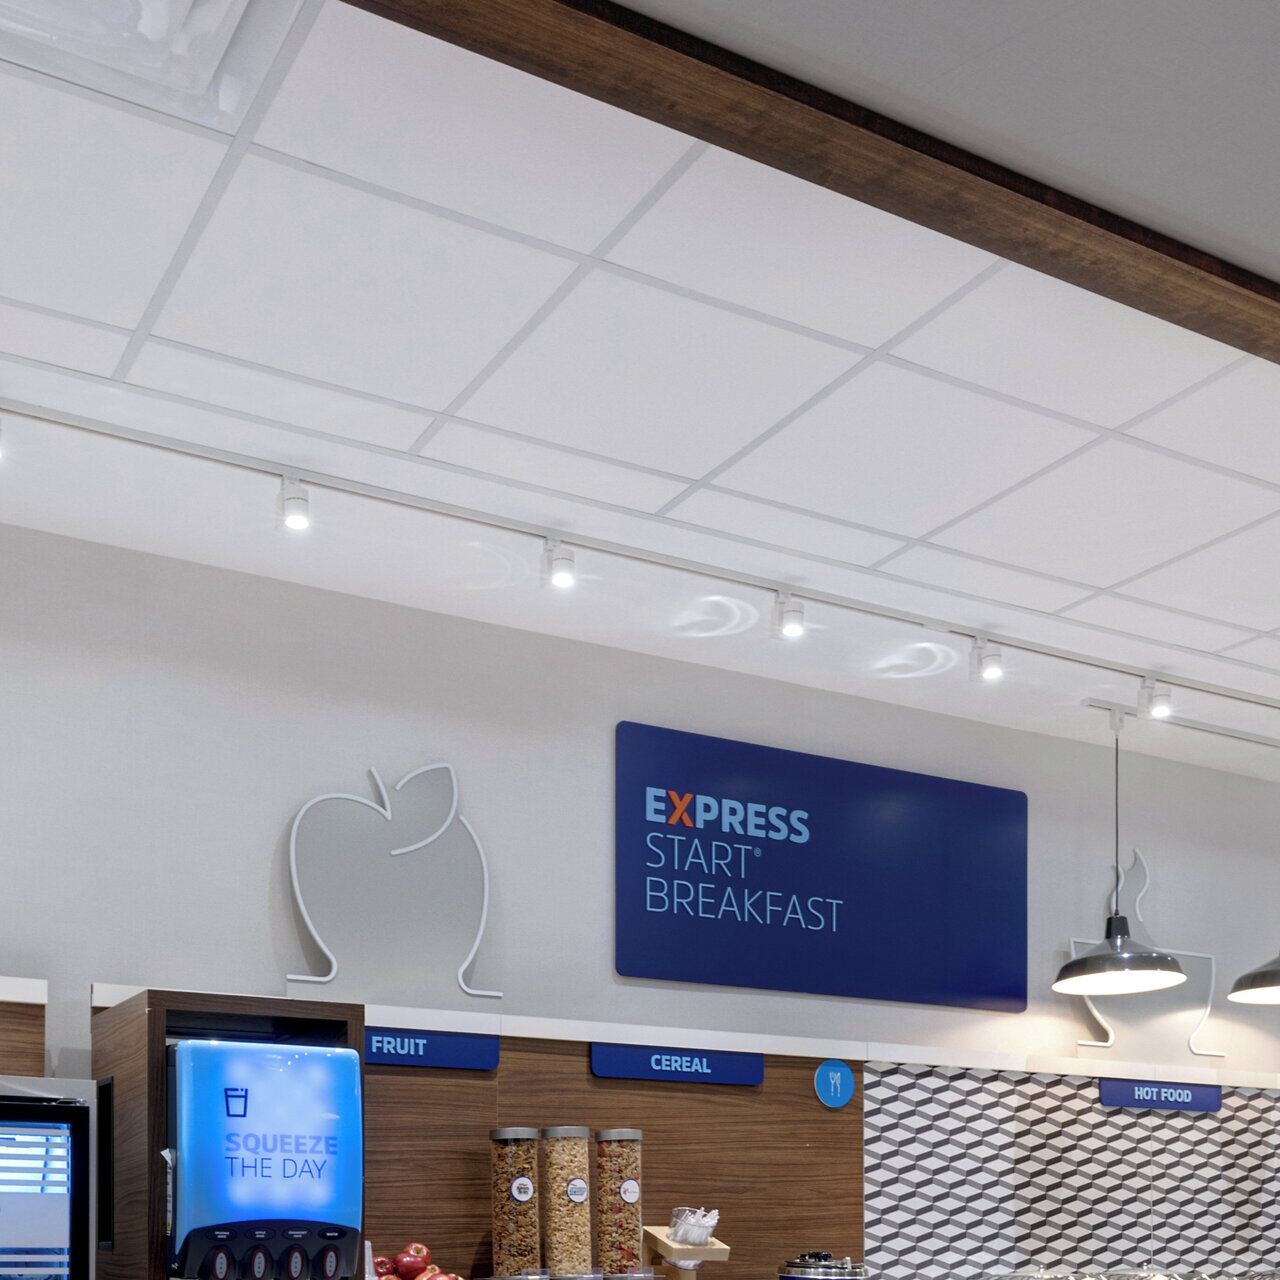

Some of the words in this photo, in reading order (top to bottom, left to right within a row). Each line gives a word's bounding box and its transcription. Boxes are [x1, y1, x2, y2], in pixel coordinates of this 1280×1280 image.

[645, 786, 810, 844] EXPRESS
[645, 876, 844, 932] BREAKFAST
[371, 1036, 427, 1056] FRUIT
[650, 1054, 712, 1073] CEREAL
[1134, 1086, 1159, 1101] HOT
[1160, 1088, 1192, 1103] FOOD
[225, 1132, 338, 1155] SQUEEZE
[224, 1156, 272, 1178] THE
[282, 1158, 327, 1178] DAY
